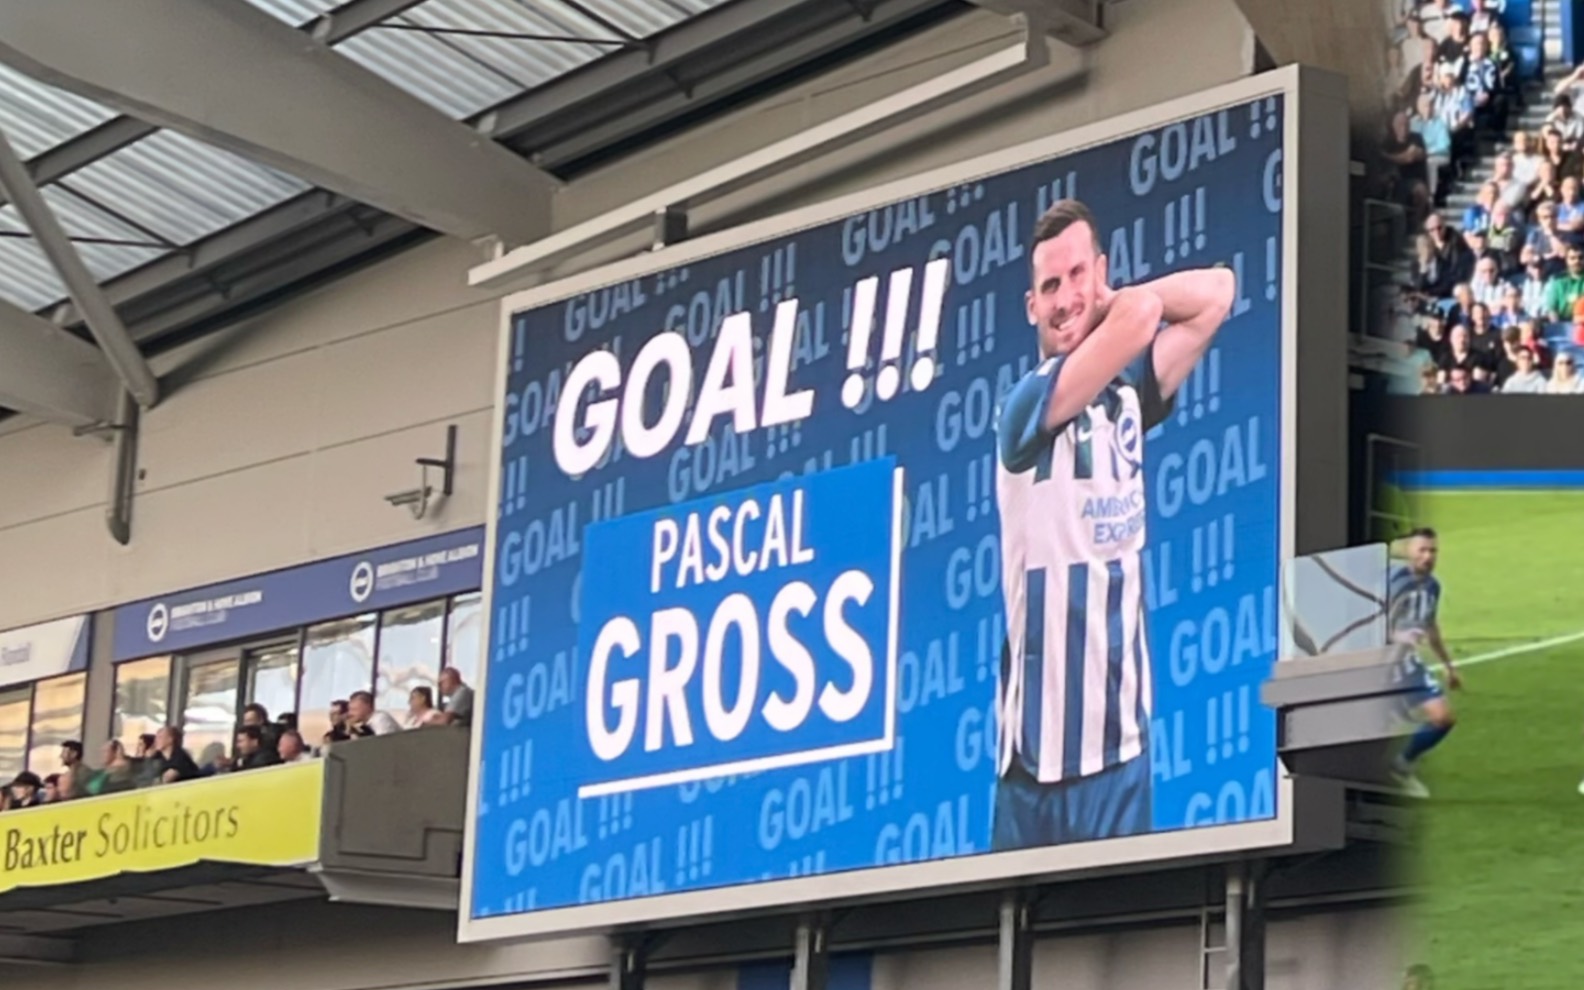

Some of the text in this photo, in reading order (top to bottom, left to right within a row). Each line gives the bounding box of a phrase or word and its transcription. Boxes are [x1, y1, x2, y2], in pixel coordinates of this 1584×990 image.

[1130, 109, 1236, 196] GOAL
[842, 195, 935, 266] GOAL
[1164, 186, 1207, 265] !!!
[554, 299, 815, 475] GOAL
[841, 257, 948, 409] !!!
[1156, 415, 1267, 518] GOAL
[501, 501, 579, 586] GOAL
[651, 488, 814, 593] PASCAL
[1191, 512, 1235, 594] !!!
[496, 595, 530, 662] !!!
[585, 569, 874, 762] GROSS
[1169, 584, 1277, 688] GOAL
[1205, 684, 1250, 766] !!!
[499, 739, 533, 806] !!!
[759, 759, 854, 850] GOAL
[4, 801, 240, 872] Baxter Solicitors
[506, 798, 587, 877] GOAL
[580, 836, 665, 904] GOAL
[676, 814, 713, 887] !!!
[875, 794, 975, 867] GOAL
